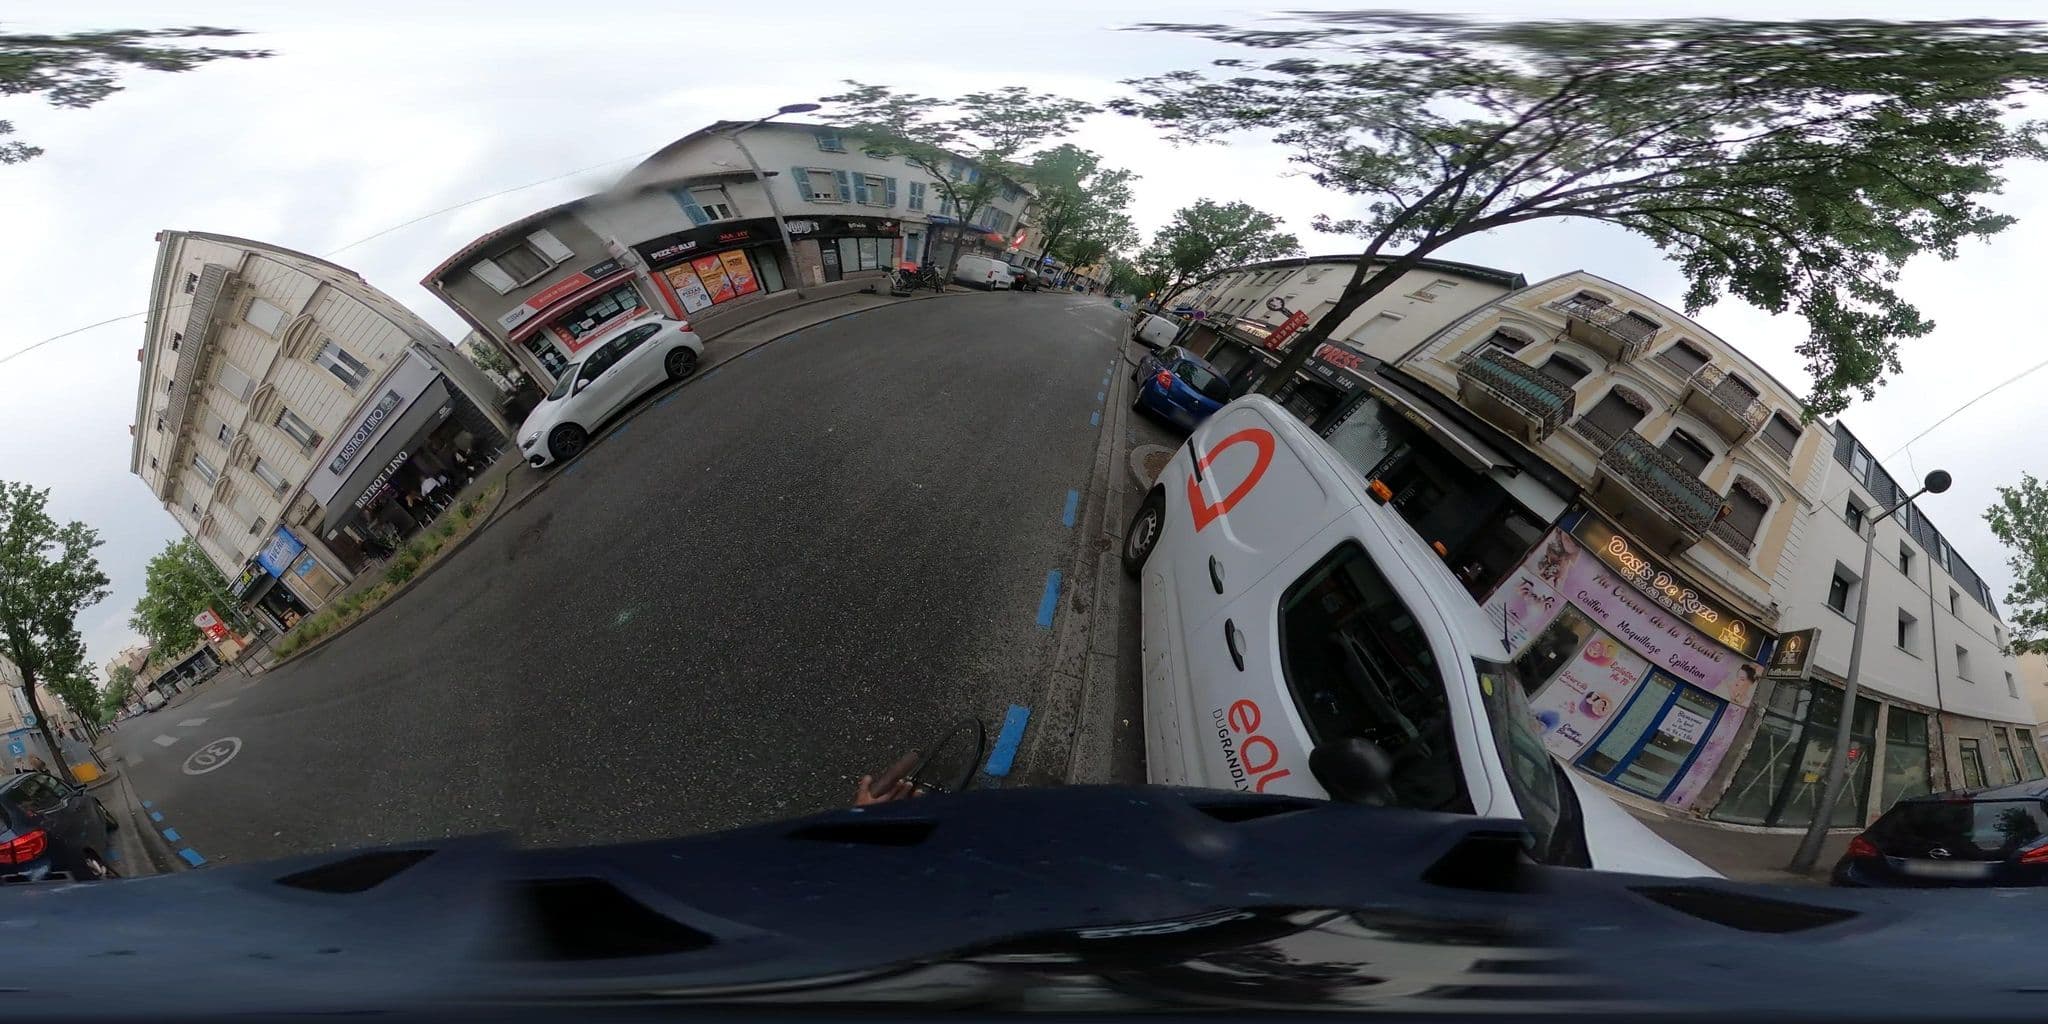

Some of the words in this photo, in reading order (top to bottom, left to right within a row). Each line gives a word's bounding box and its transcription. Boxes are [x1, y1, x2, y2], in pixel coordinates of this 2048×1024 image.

[1336, 375, 1355, 389] TACOS
[341, 429, 369, 461] BISTROT
[366, 409, 384, 431] LINO
[354, 473, 387, 508] BISTROT
[385, 451, 408, 476] LINO
[1608, 535, 1655, 580] Oasis
[1653, 570, 1679, 596] De
[1678, 587, 1719, 623] Roza
[1576, 590, 1610, 620] Coiffure
[1617, 619, 1661, 655] Maquillage
[1668, 653, 1706, 680] Epilation
[1666, 625, 1680, 639] la
